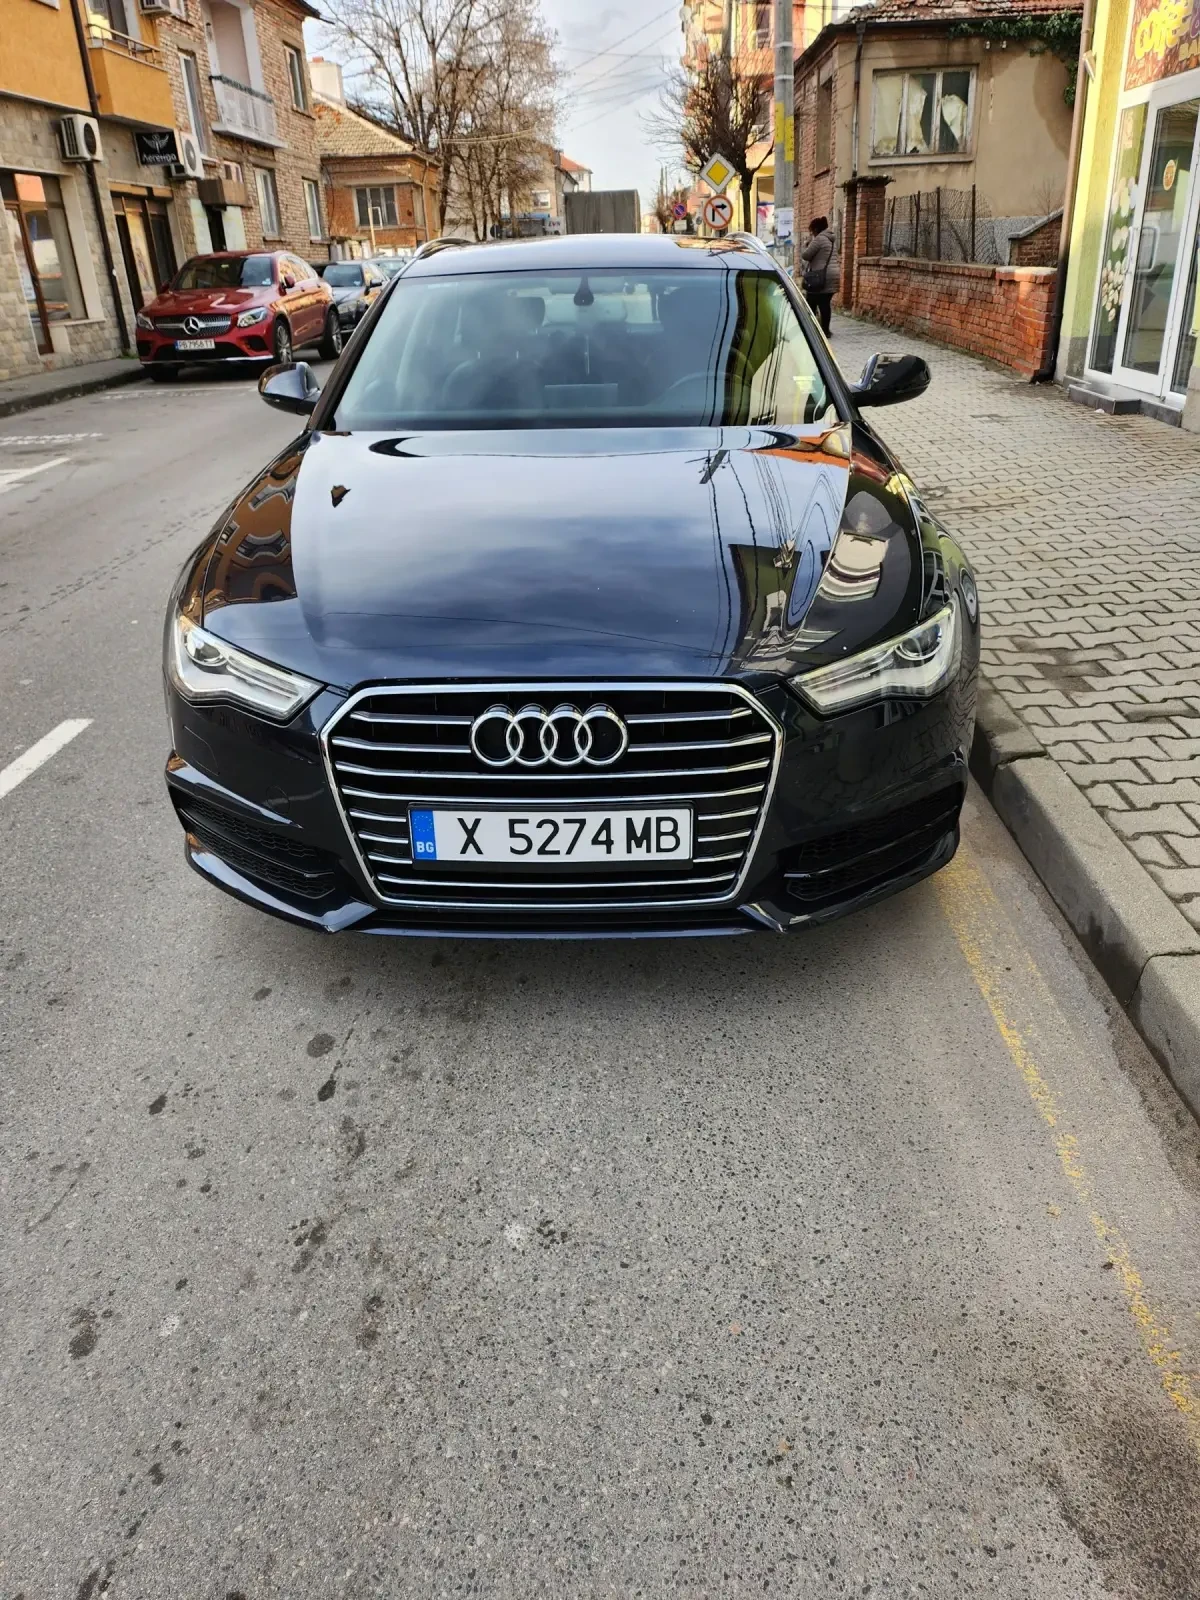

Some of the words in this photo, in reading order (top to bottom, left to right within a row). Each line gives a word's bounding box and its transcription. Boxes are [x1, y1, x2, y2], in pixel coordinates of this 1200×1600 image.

[416, 841, 434, 853] BG
[457, 818, 484, 855] X
[508, 818, 614, 855] 5274
[626, 816, 681, 854] MB
